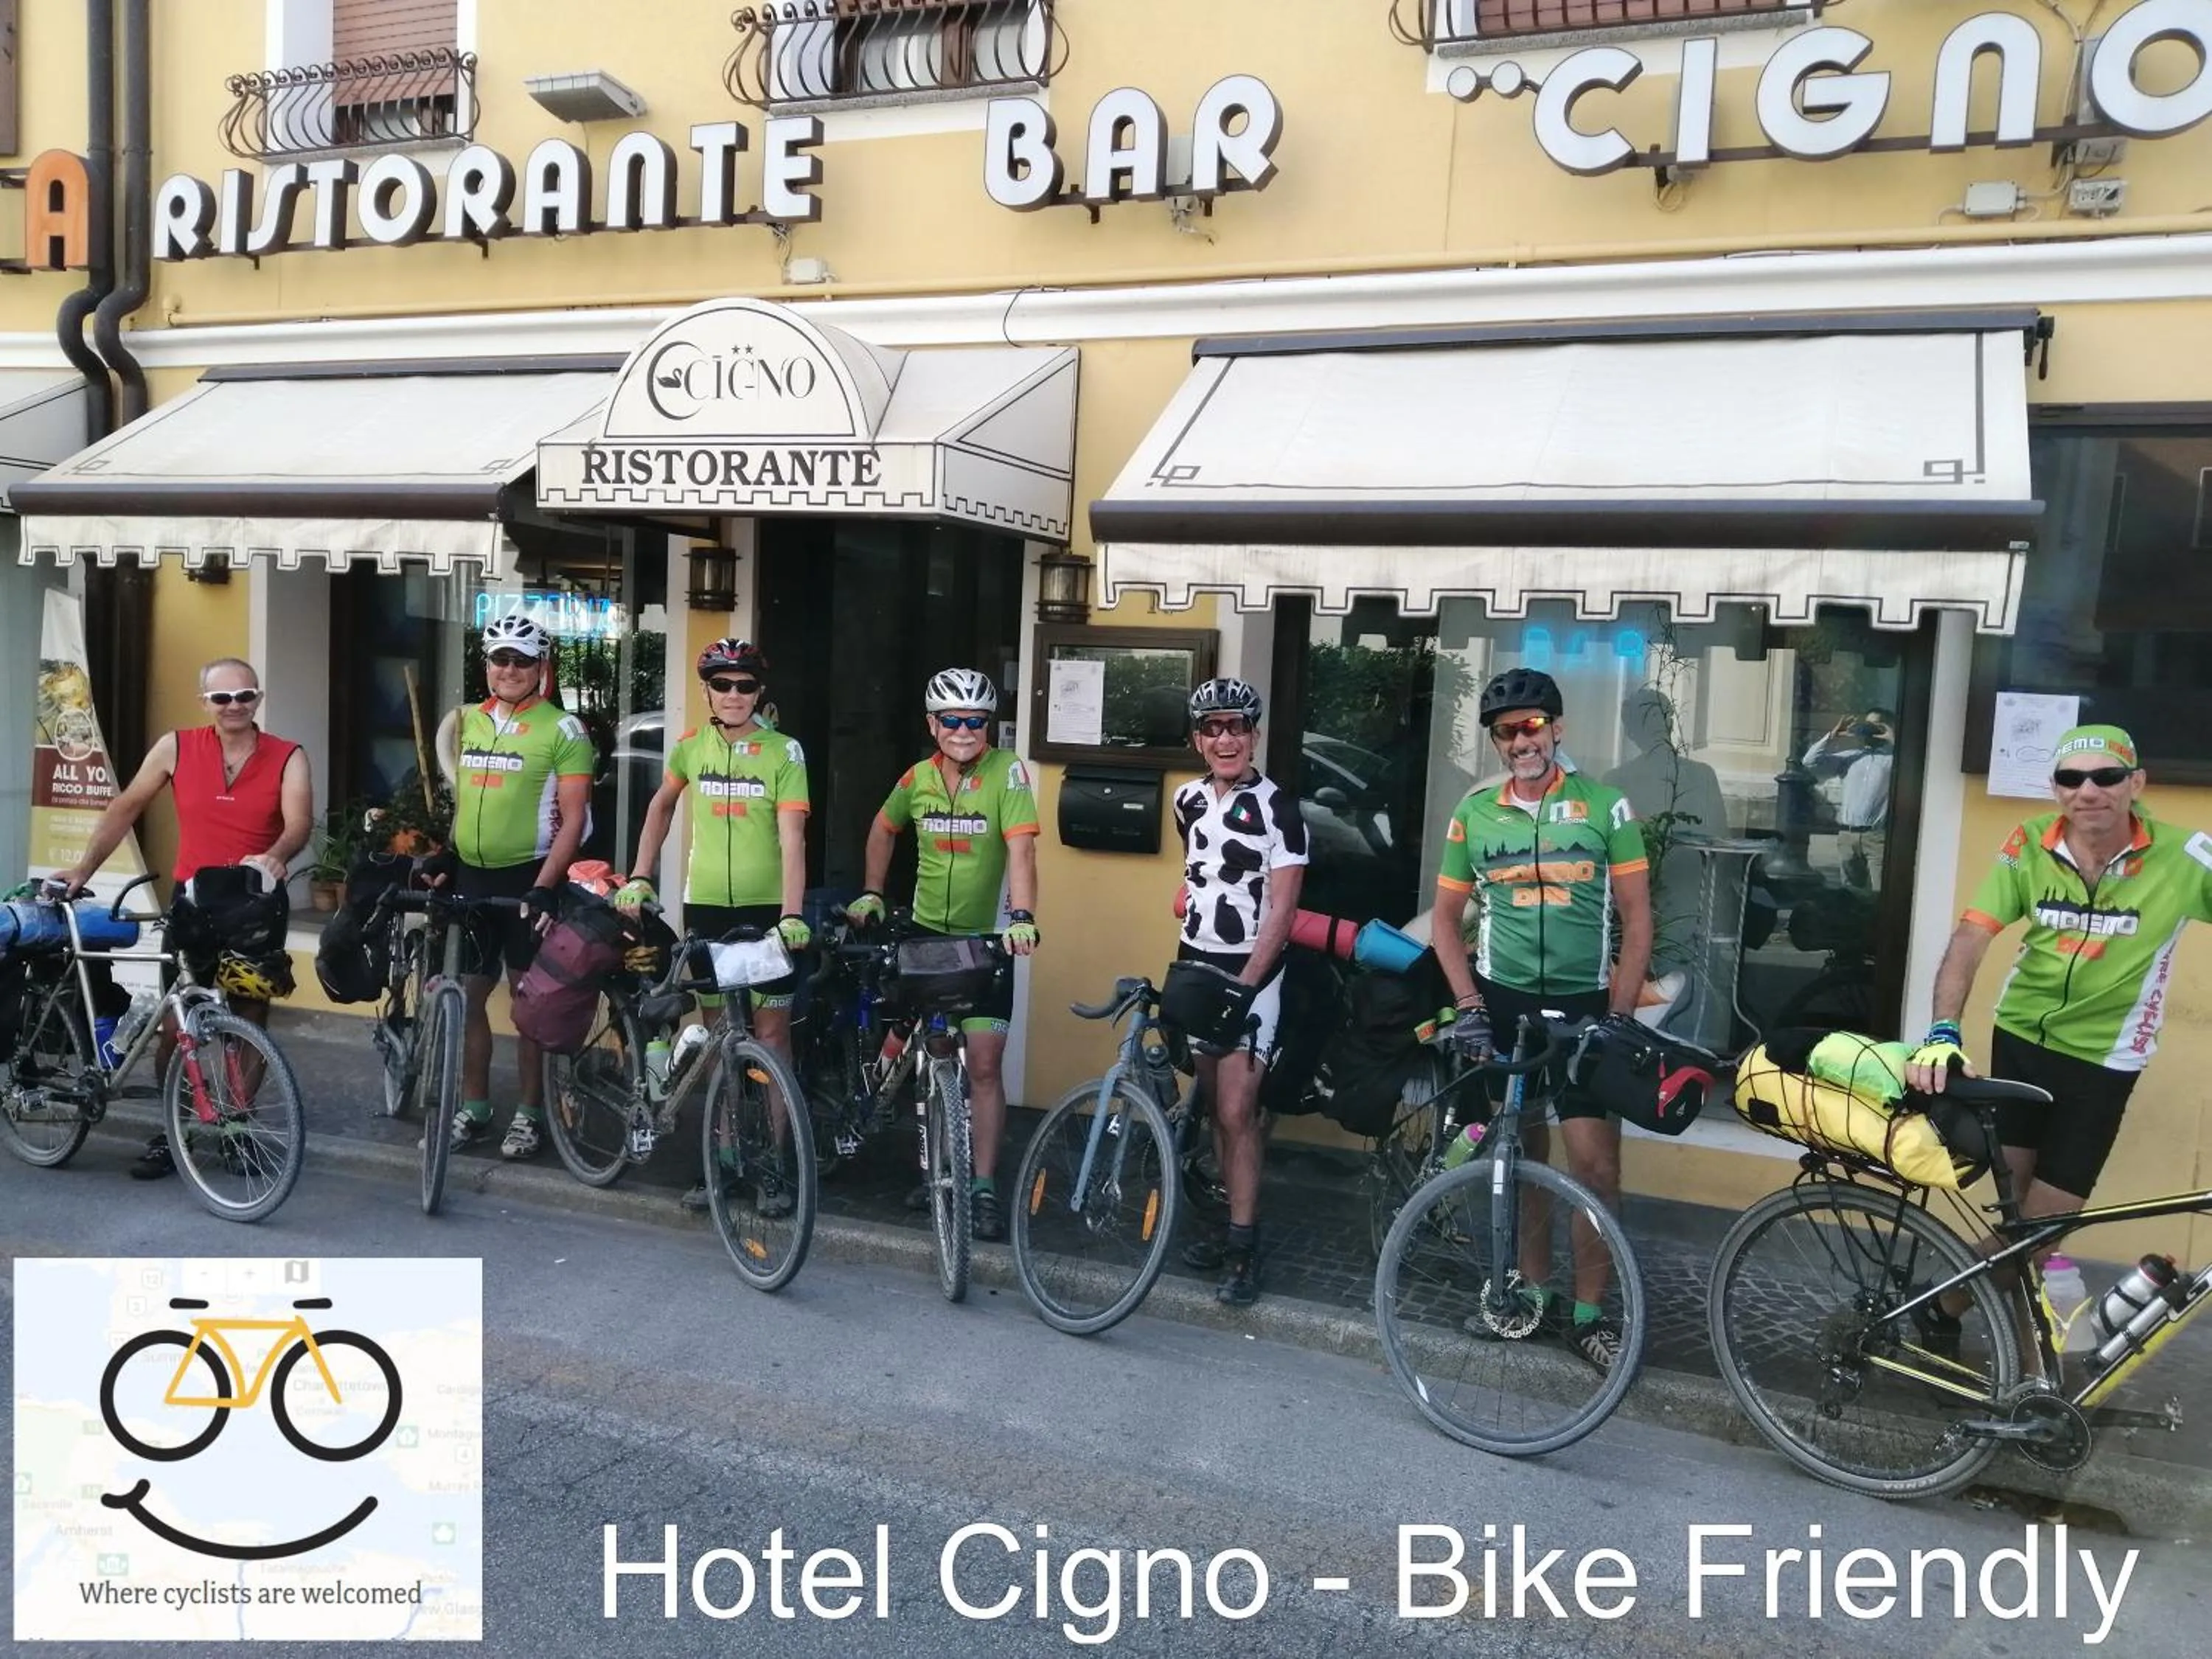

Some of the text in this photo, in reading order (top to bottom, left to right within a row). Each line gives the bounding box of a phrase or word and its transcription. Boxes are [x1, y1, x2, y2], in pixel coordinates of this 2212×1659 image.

[1533, 0, 2212, 176] CIGNO
[153, 74, 1283, 261] RISTORANTE BAR
[683, 354, 816, 400] CIGNO
[582, 449, 882, 487] RISTORANTE
[52, 764, 110, 783] ALL YO
[52, 782, 83, 795] RICCO
